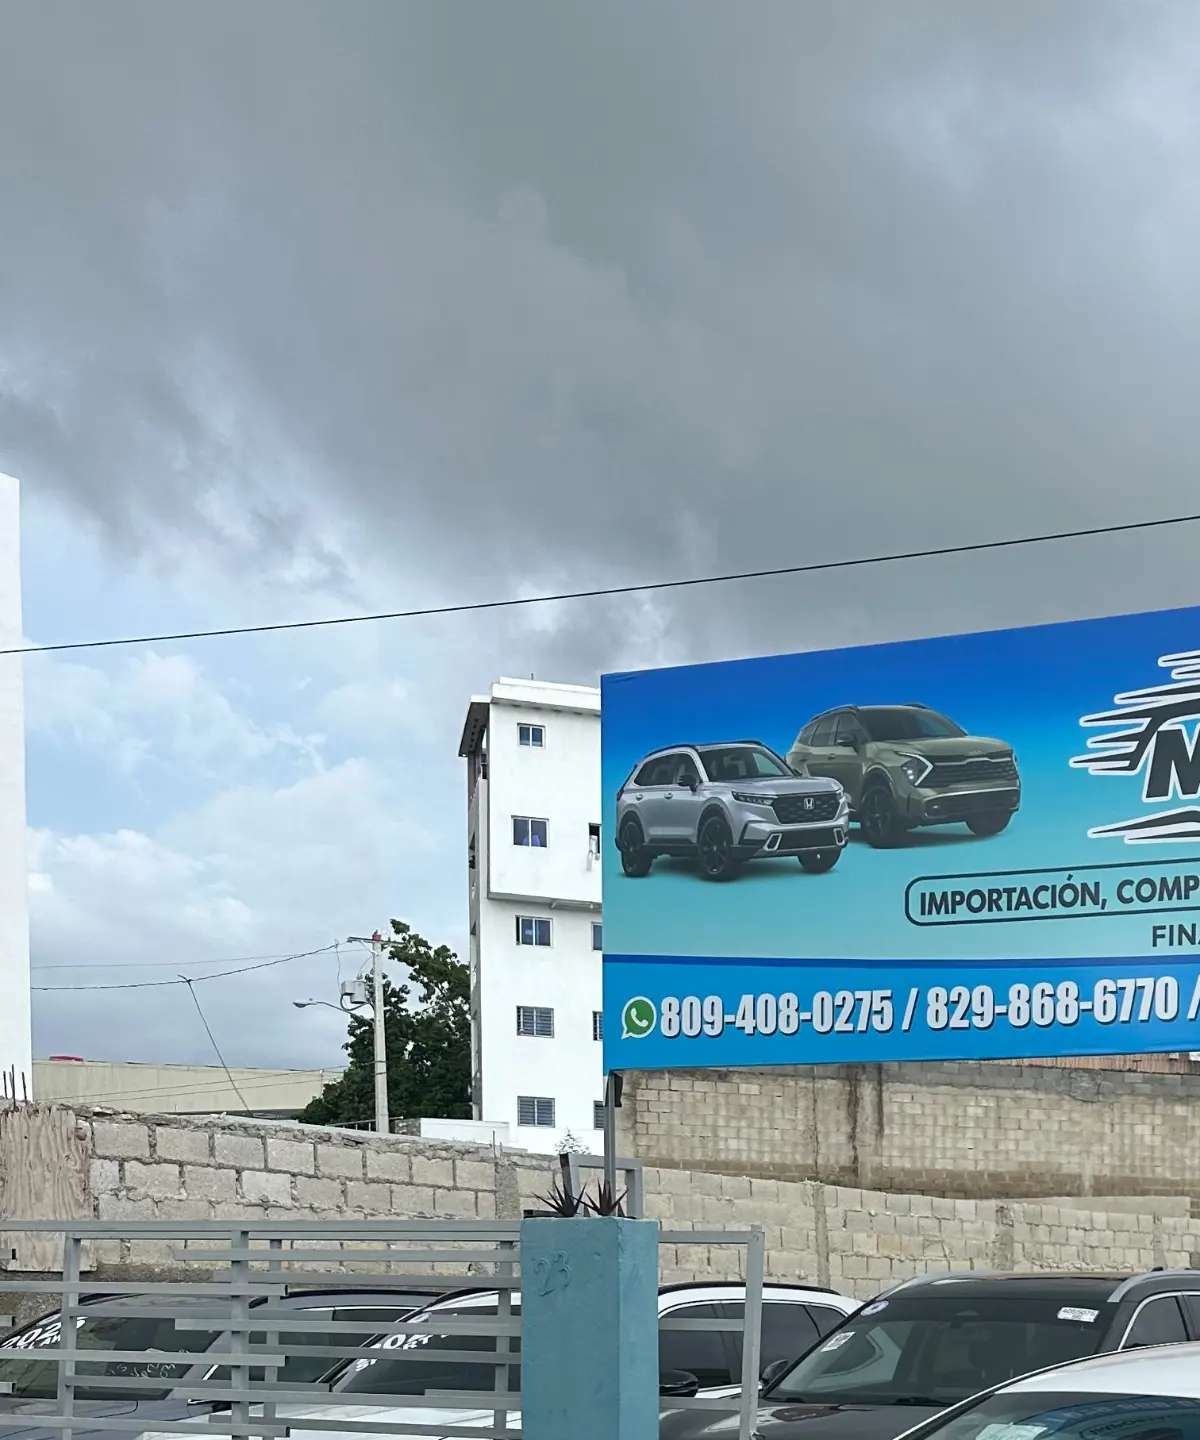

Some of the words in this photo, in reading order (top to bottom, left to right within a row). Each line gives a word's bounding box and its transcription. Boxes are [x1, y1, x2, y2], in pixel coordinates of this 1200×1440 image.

[919, 874, 1108, 917] IMPORTACIÓN,
[660, 988, 894, 1038] 809-408-0275
[926, 975, 1179, 1030] 829-868-6770
